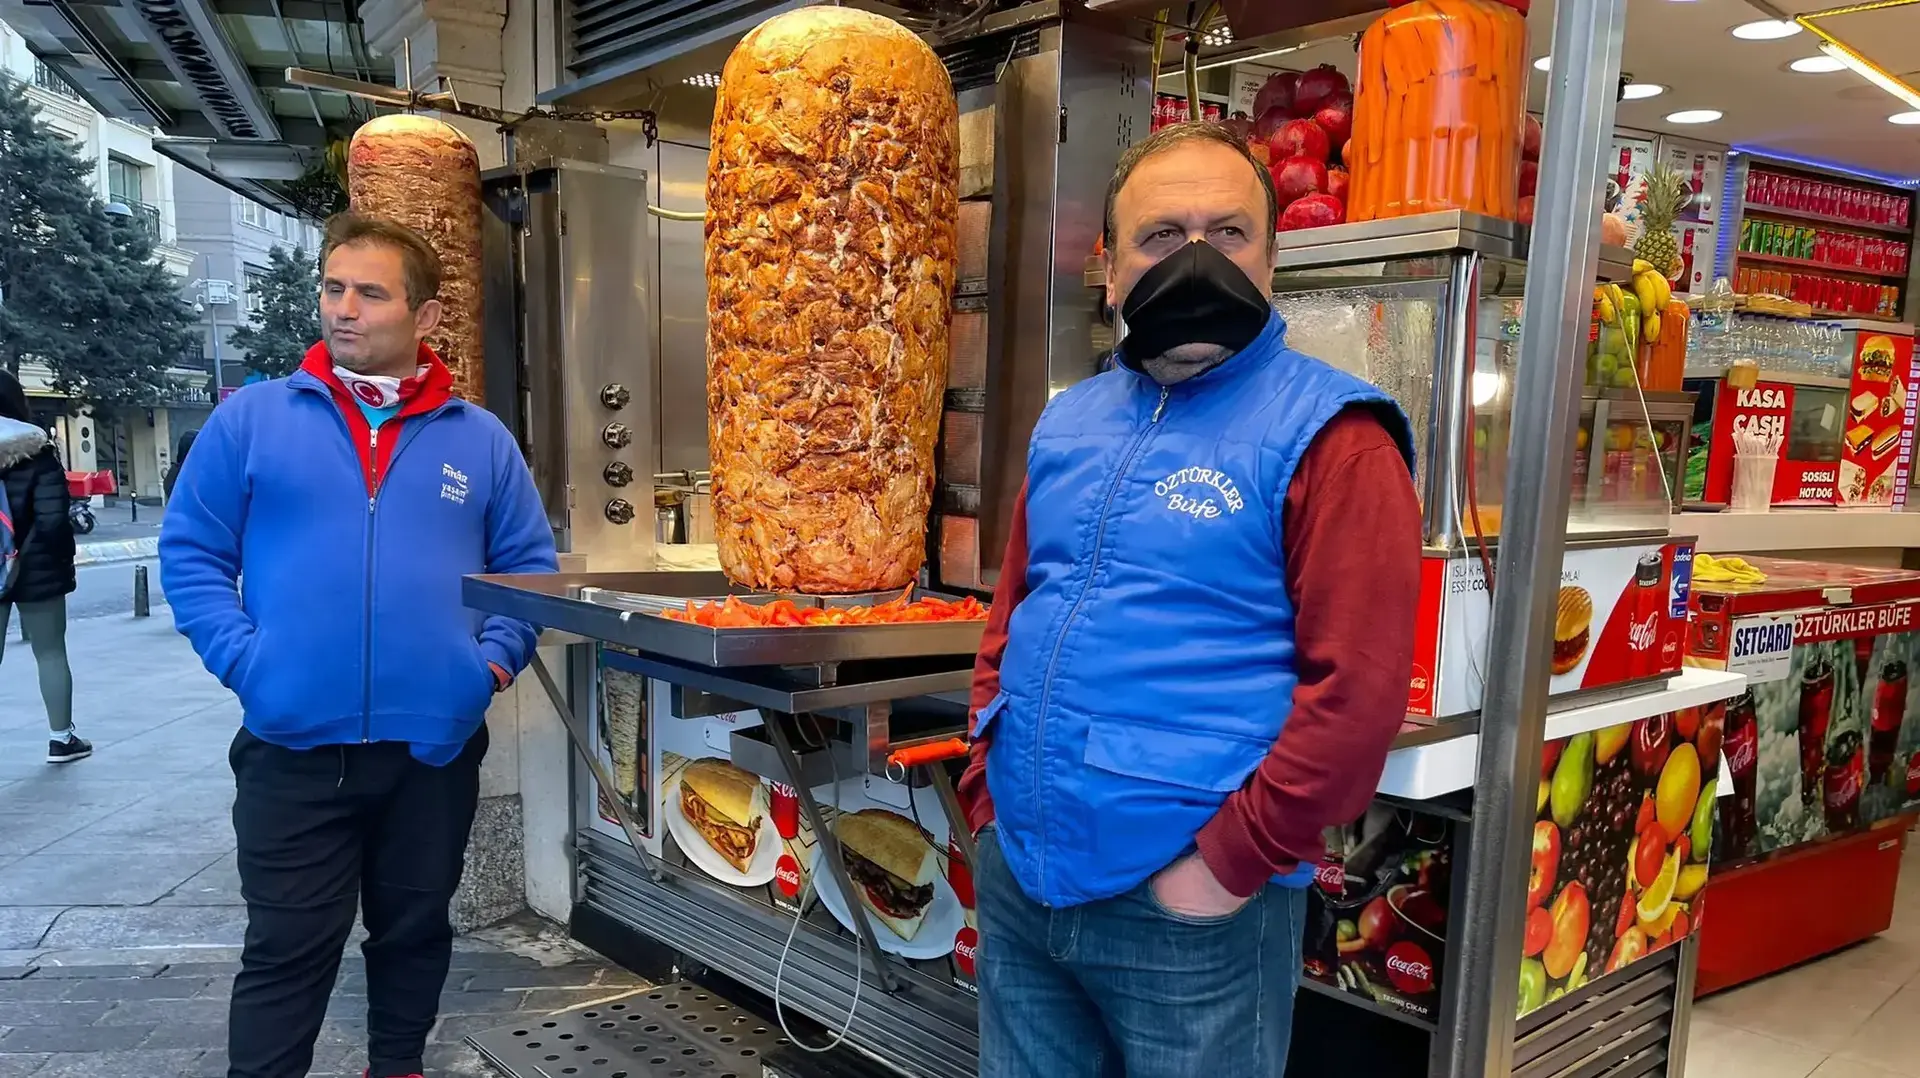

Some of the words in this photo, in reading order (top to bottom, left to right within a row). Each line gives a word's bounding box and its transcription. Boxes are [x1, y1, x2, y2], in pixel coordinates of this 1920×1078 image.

[1736, 389, 1786, 409] KASA
[1733, 414, 1786, 437] CASH
[1799, 487, 1817, 499] HOT
[1817, 488, 1833, 499] DOG
[1167, 494, 1222, 519] Büfe
[1793, 610, 1876, 638] ÖZTÜRKLER
[1878, 604, 1912, 629] BÜFE
[1734, 623, 1793, 657] SETCARD
[1405, 1002, 1428, 1014] ÇIKAR
